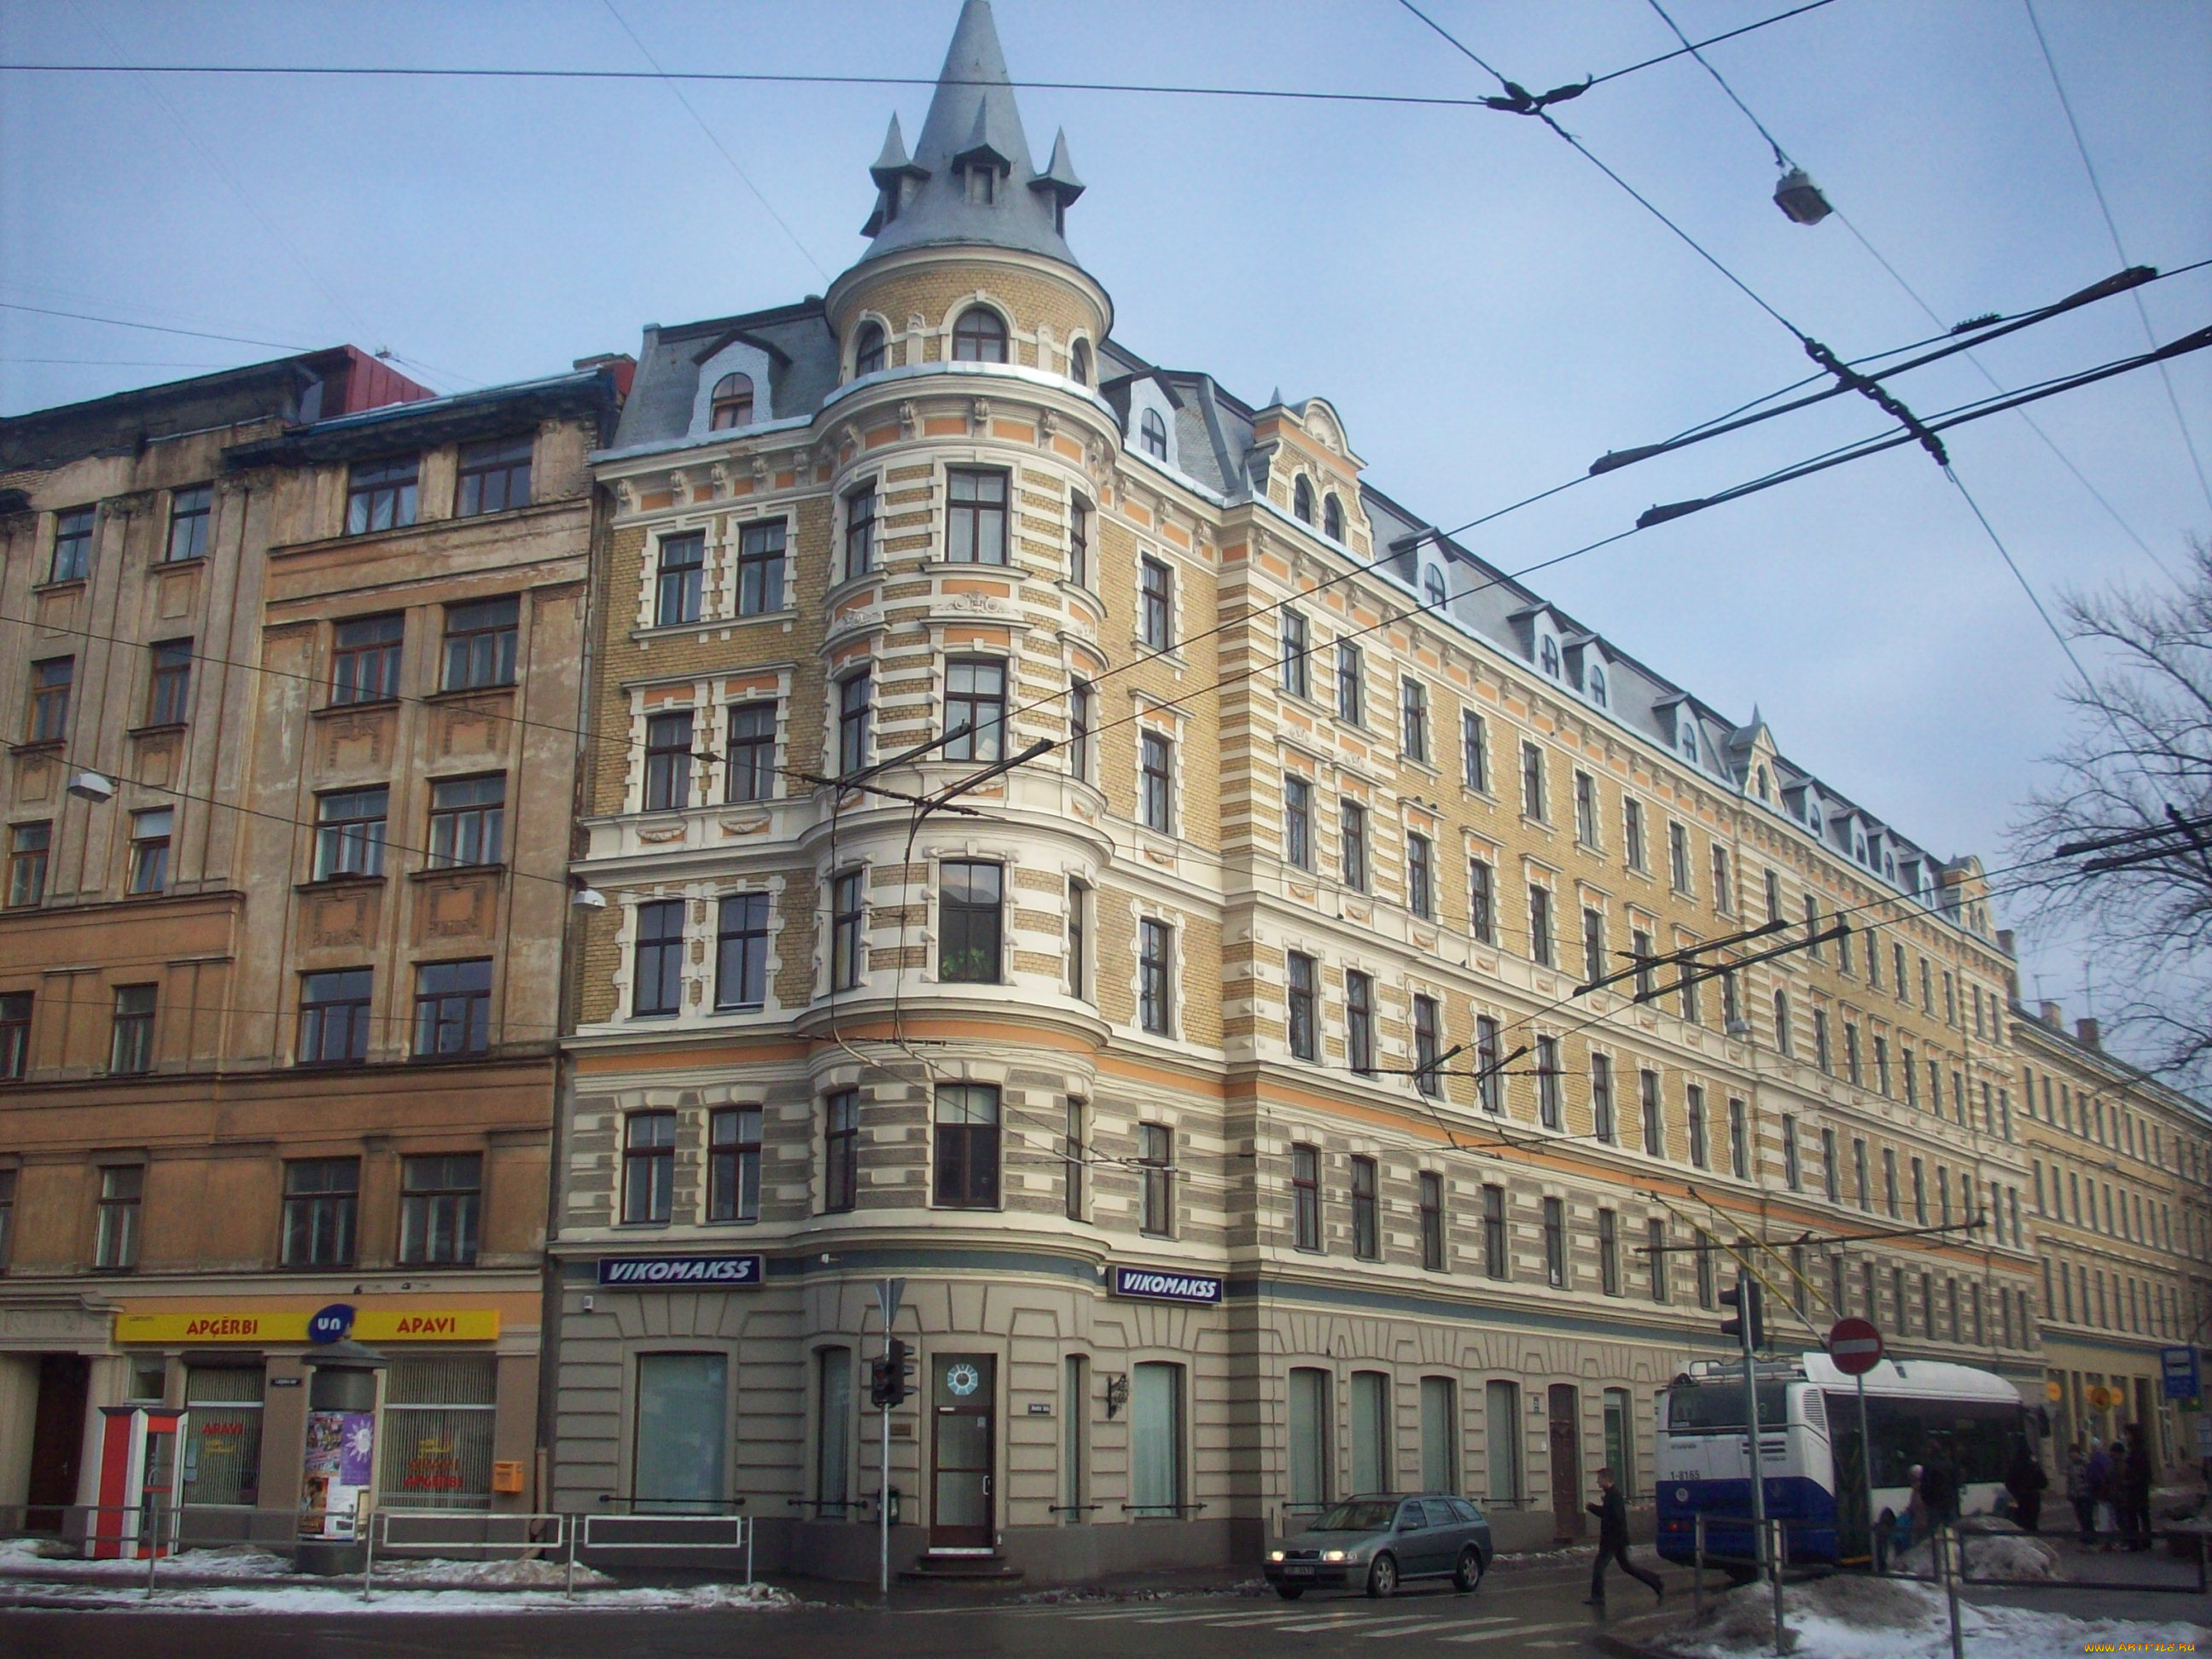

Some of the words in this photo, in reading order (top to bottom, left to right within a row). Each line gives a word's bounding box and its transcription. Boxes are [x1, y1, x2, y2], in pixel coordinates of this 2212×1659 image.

[608, 1260, 752, 1280] VIKOMAKSS
[1123, 1272, 1217, 1297] VIKOMAKSS
[186, 1317, 258, 1337] APĢĒRBI
[396, 1318, 455, 1333] APAVI
[201, 1423, 244, 1435] APAVI
